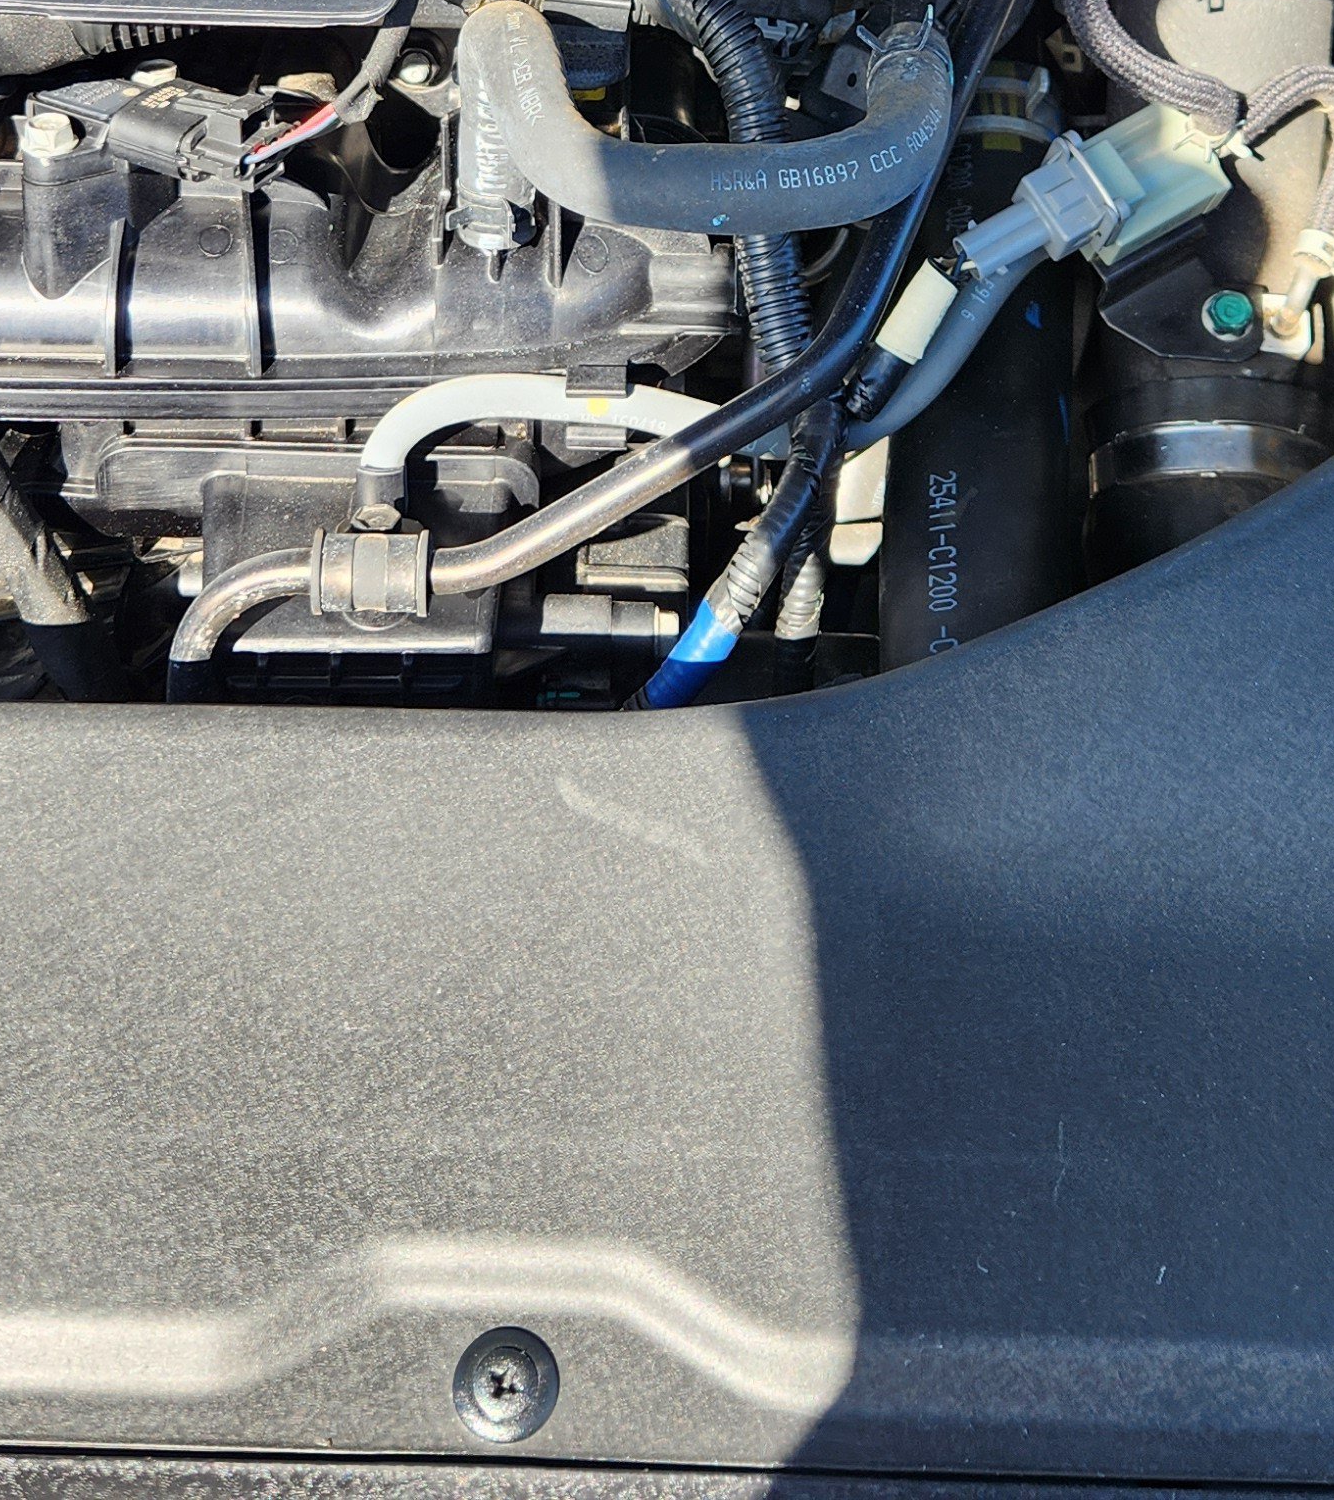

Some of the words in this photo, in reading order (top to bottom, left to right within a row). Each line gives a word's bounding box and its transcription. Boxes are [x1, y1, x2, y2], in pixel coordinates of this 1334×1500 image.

[710, 169, 767, 191] HSR&A
[778, 161, 860, 189] GB16897
[870, 145, 903, 173] CCC
[926, 469, 959, 612] 25411-C1200
